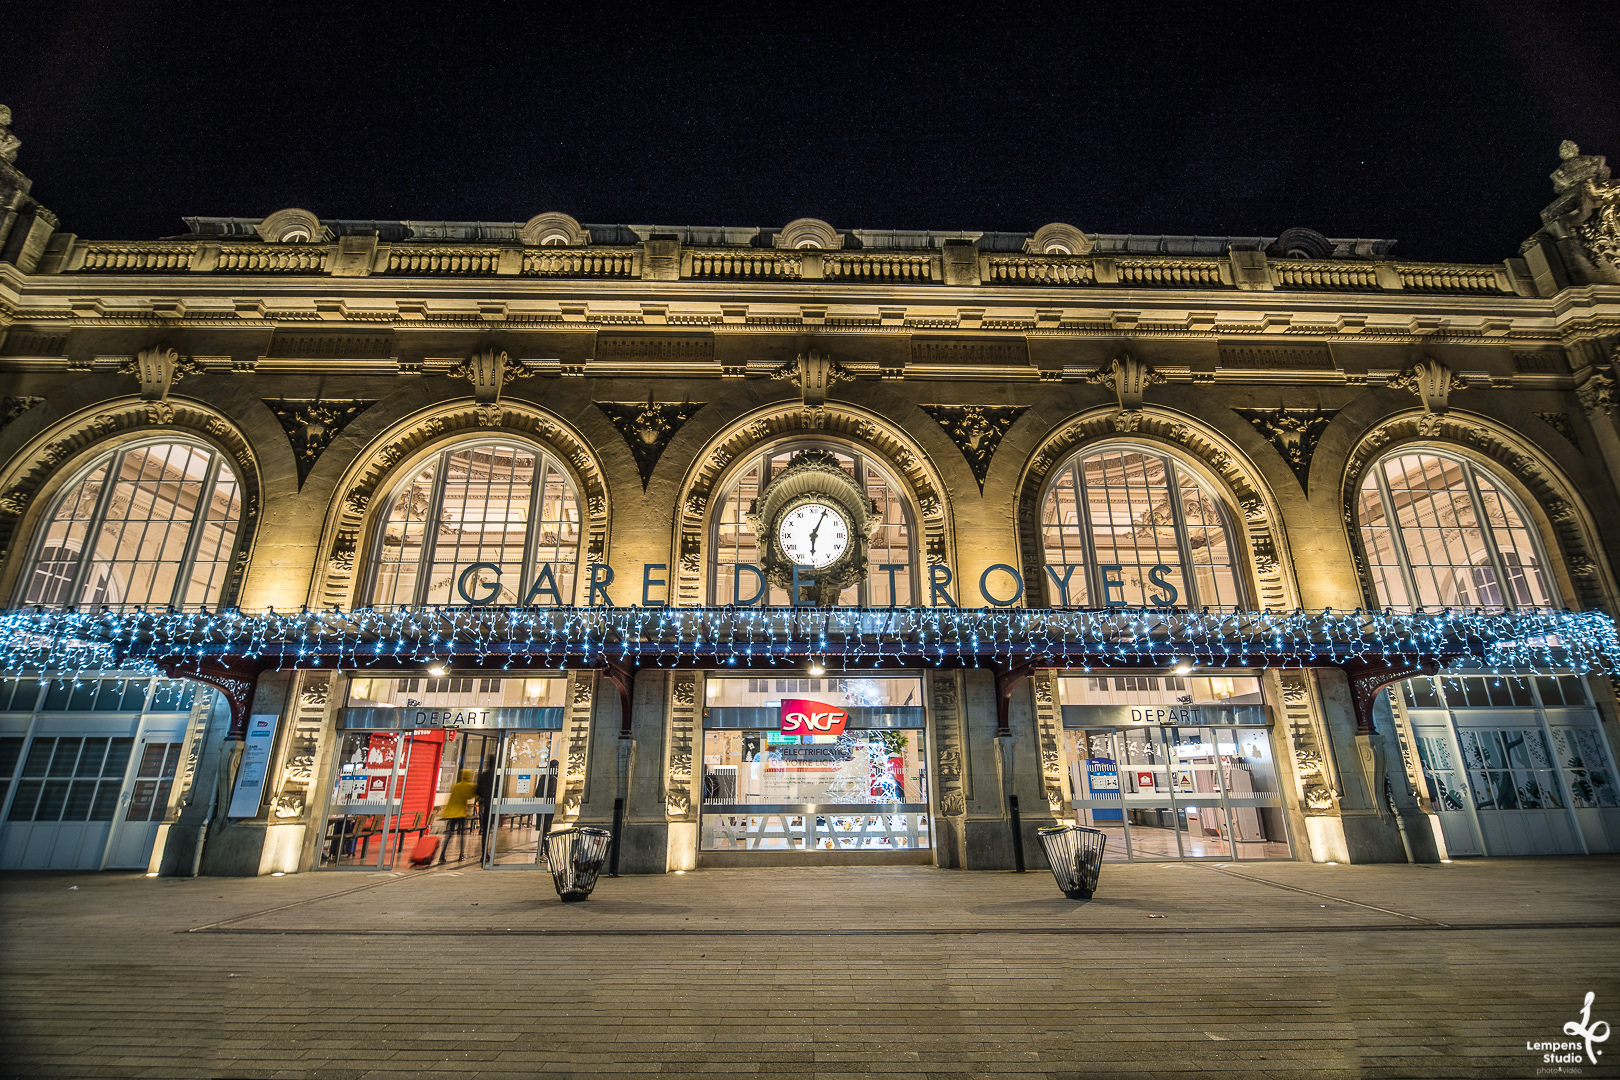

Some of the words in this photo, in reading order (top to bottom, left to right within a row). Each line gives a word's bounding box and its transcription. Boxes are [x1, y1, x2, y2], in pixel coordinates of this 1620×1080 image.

[458, 562, 668, 606] GARE
[733, 563, 815, 606] DE
[878, 563, 1179, 606] TROYES
[415, 711, 490, 725] DEPART
[782, 712, 845, 732] SNCF
[1131, 709, 1200, 722] DEPART
